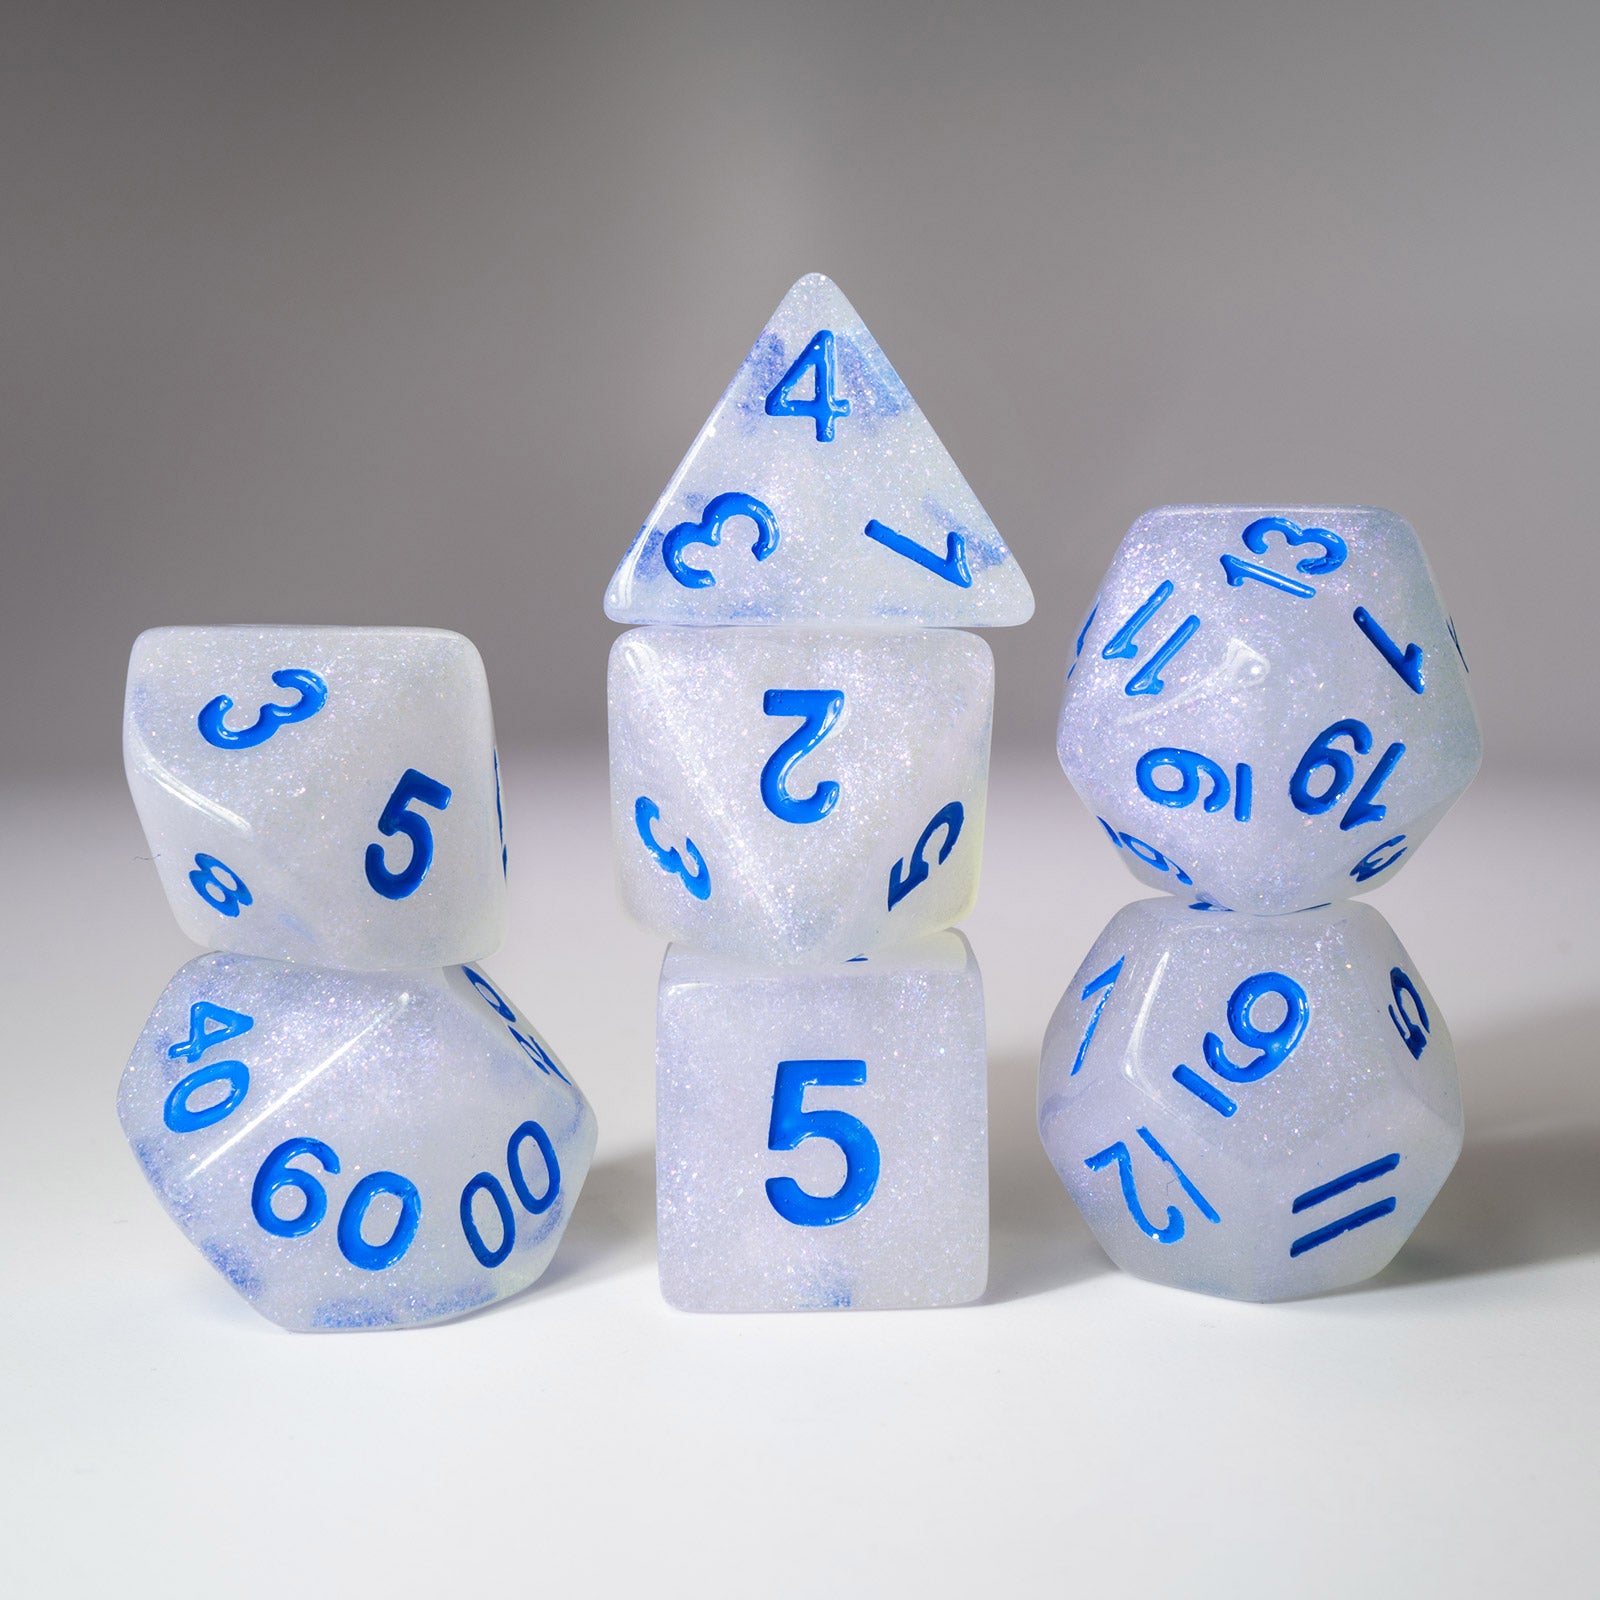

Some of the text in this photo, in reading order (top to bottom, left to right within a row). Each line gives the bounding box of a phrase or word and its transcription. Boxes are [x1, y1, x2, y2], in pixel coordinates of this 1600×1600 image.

[765, 329, 852, 443] 4
[662, 491, 781, 589] 3
[864, 519, 972, 588] 1
[1219, 516, 1348, 599] 13
[1102, 579, 1200, 696] 11
[1353, 606, 1426, 695] 1
[198, 668, 328, 750] 3
[760, 688, 845, 825] 2
[1288, 718, 1407, 832] 19
[188, 852, 253, 918] 8
[365, 768, 452, 901] 5
[634, 795, 712, 901] 3
[887, 801, 965, 912] 5
[163, 1000, 255, 1134] 40
[459, 1120, 561, 1269] 00
[765, 1059, 882, 1227] 5
[1083, 1125, 1222, 1245] 12
[250, 1136, 422, 1272] 60
[1290, 1153, 1401, 1258] 11
